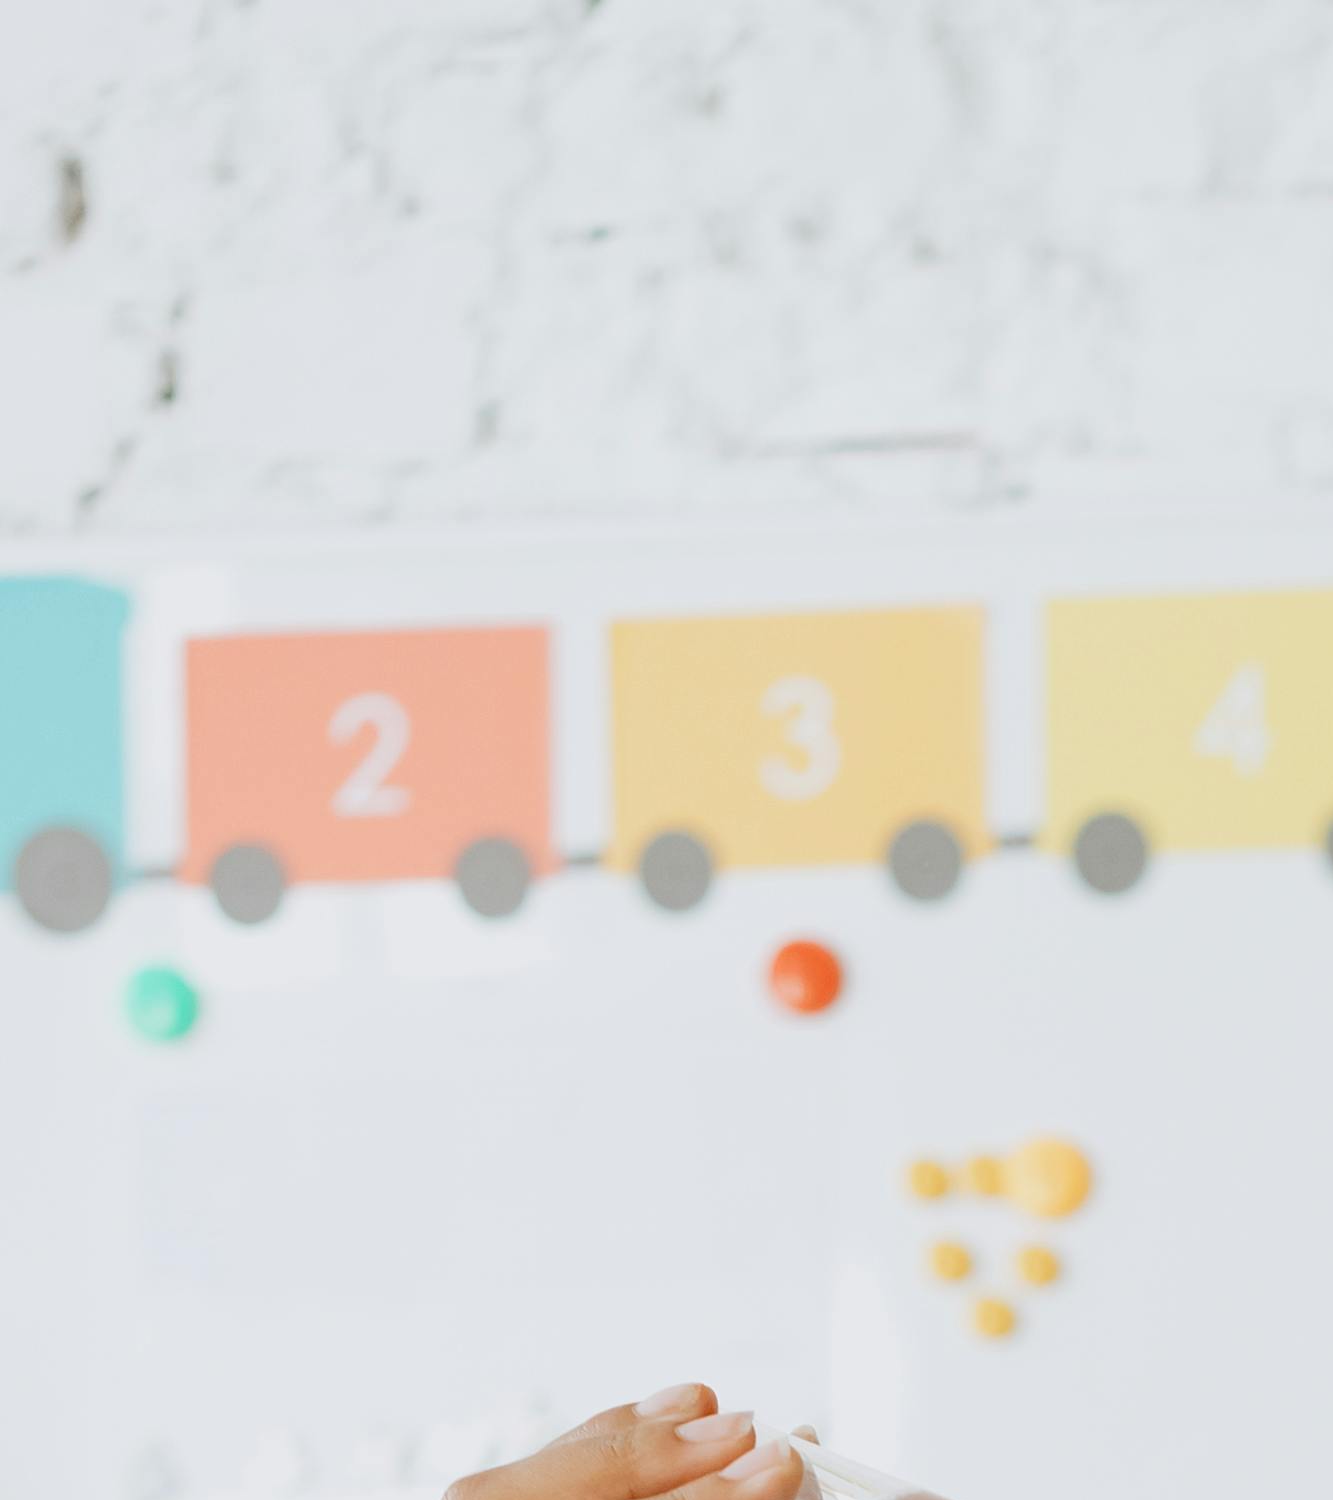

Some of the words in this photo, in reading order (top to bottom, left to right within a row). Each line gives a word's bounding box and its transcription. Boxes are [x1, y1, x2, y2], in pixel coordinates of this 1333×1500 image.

[329, 692, 410, 818] 2
[759, 675, 841, 801] 3
[1194, 662, 1272, 776] 4
